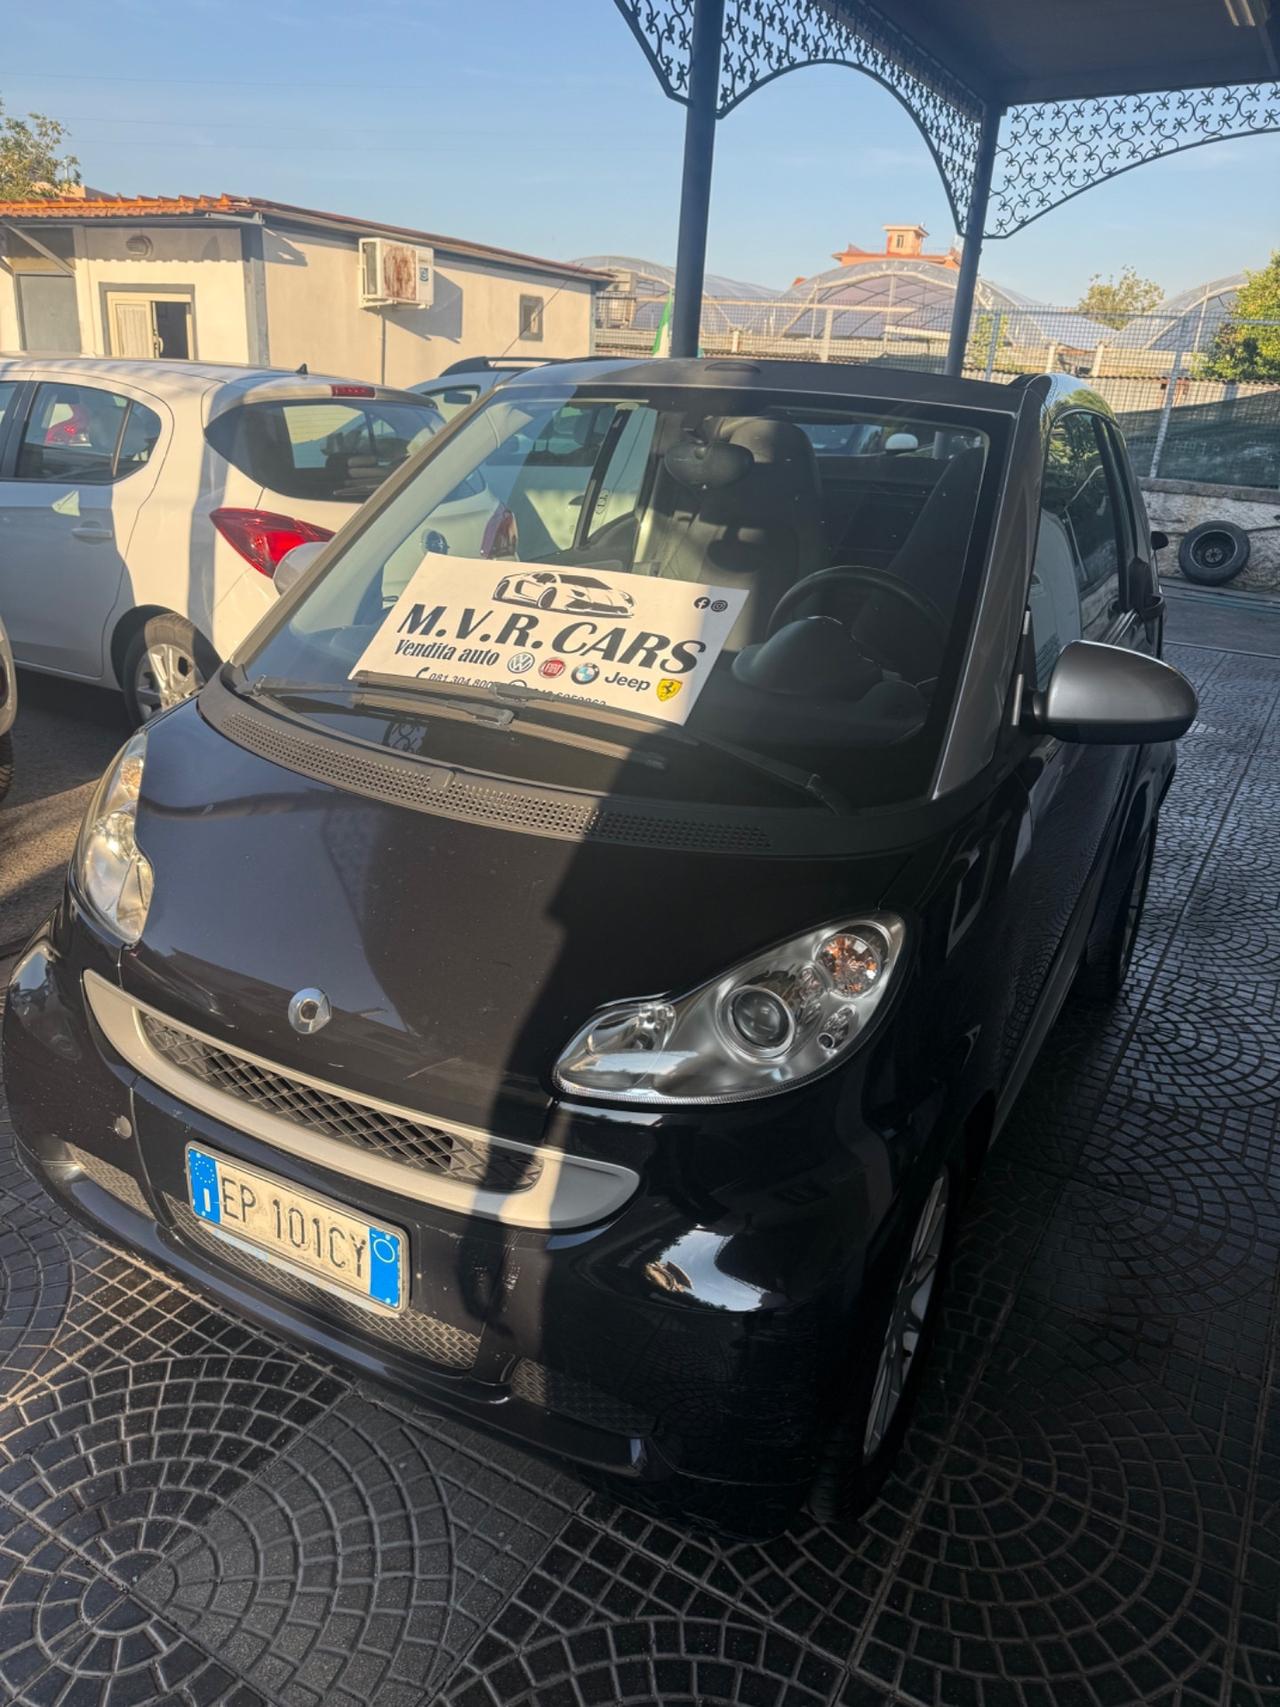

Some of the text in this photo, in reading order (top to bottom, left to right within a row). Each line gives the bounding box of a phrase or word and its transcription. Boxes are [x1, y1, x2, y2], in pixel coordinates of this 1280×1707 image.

[394, 639, 501, 667] Vendita auto
[551, 621, 706, 674] CARS
[604, 672, 651, 692] Jeep
[222, 1177, 367, 1278] EP 101CY
